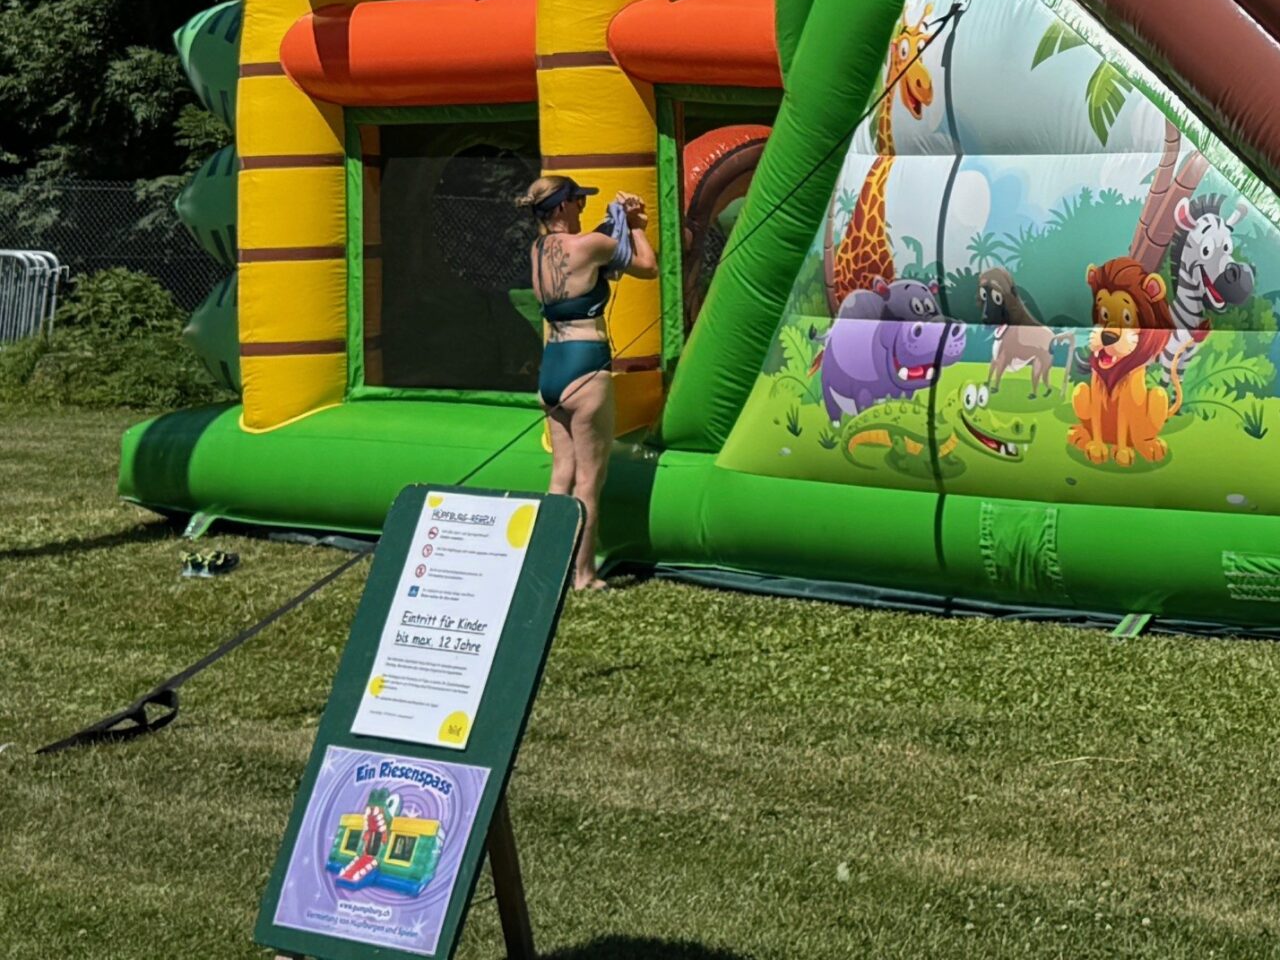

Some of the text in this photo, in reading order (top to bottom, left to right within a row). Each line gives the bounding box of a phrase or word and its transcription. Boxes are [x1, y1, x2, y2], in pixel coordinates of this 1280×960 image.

[402, 610, 488, 632] Eintritt für Kinder
[395, 630, 409, 643] bis
[439, 635, 452, 649] 12
[454, 637, 481, 652] Jahre
[356, 761, 453, 795] Ein Riesenspass
